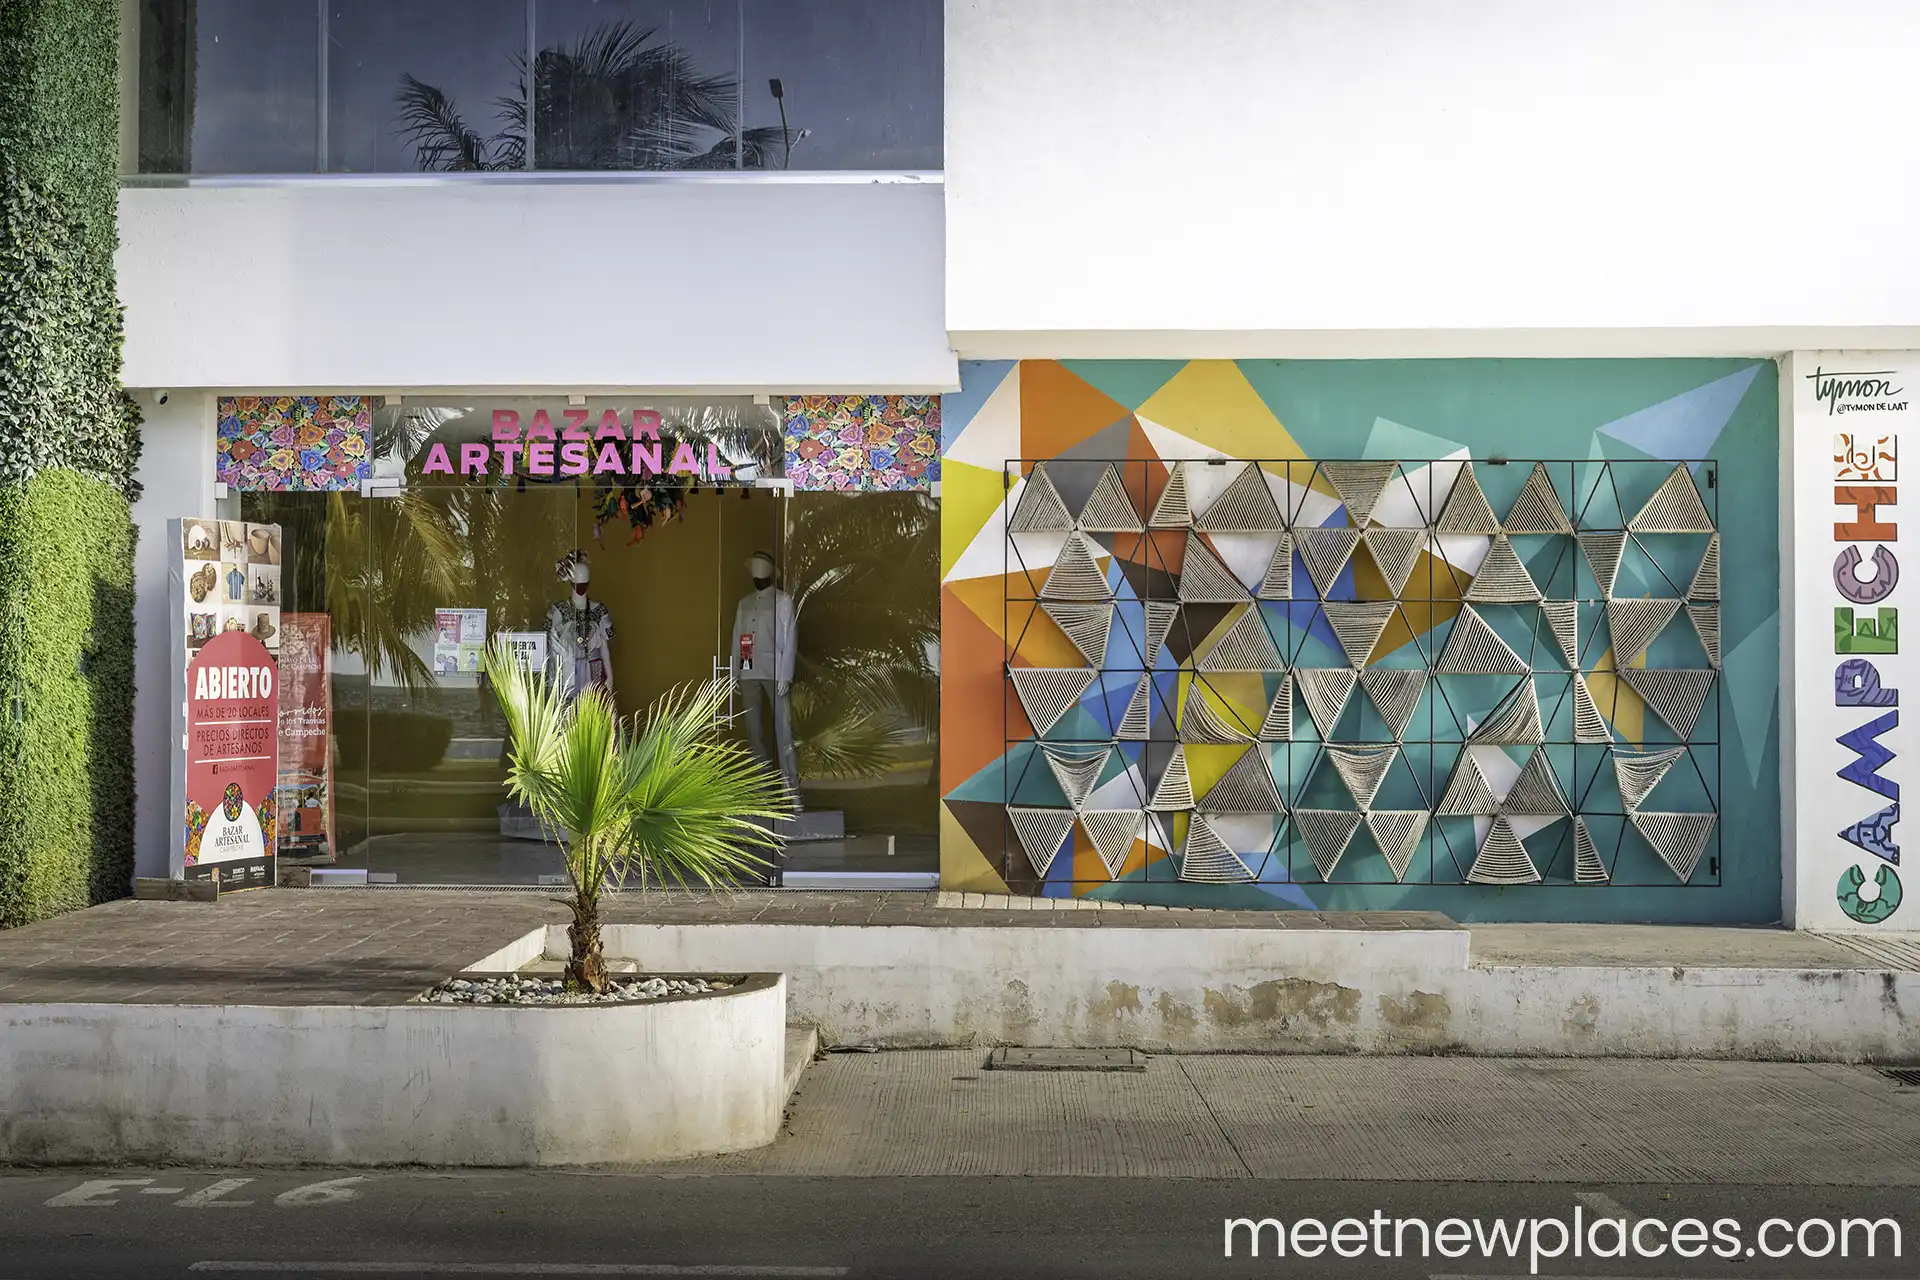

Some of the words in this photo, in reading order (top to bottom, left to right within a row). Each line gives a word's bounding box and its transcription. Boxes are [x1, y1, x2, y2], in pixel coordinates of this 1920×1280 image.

[1806, 366, 1904, 416] tymon
[1837, 403, 1875, 414] @TYMON
[1877, 403, 1887, 411] DE
[1888, 402, 1909, 411] LAAT
[492, 409, 662, 441] BAZAR
[422, 443, 732, 475] ARTESANAL
[195, 666, 272, 700] ABIERTO
[1833, 433, 1903, 924] CAMPECHE
[196, 705, 213, 719] MÁS
[216, 707, 225, 718] DE
[228, 707, 237, 718] 20
[239, 706, 270, 717] LOCALES
[196, 729, 230, 742] PRECIOS
[285, 727, 326, 738] Campeche
[204, 744, 214, 756] DE
[216, 742, 263, 755] ARTESANOS
[222, 825, 243, 836] BAZAR
[215, 834, 250, 847] ARTESANAL
